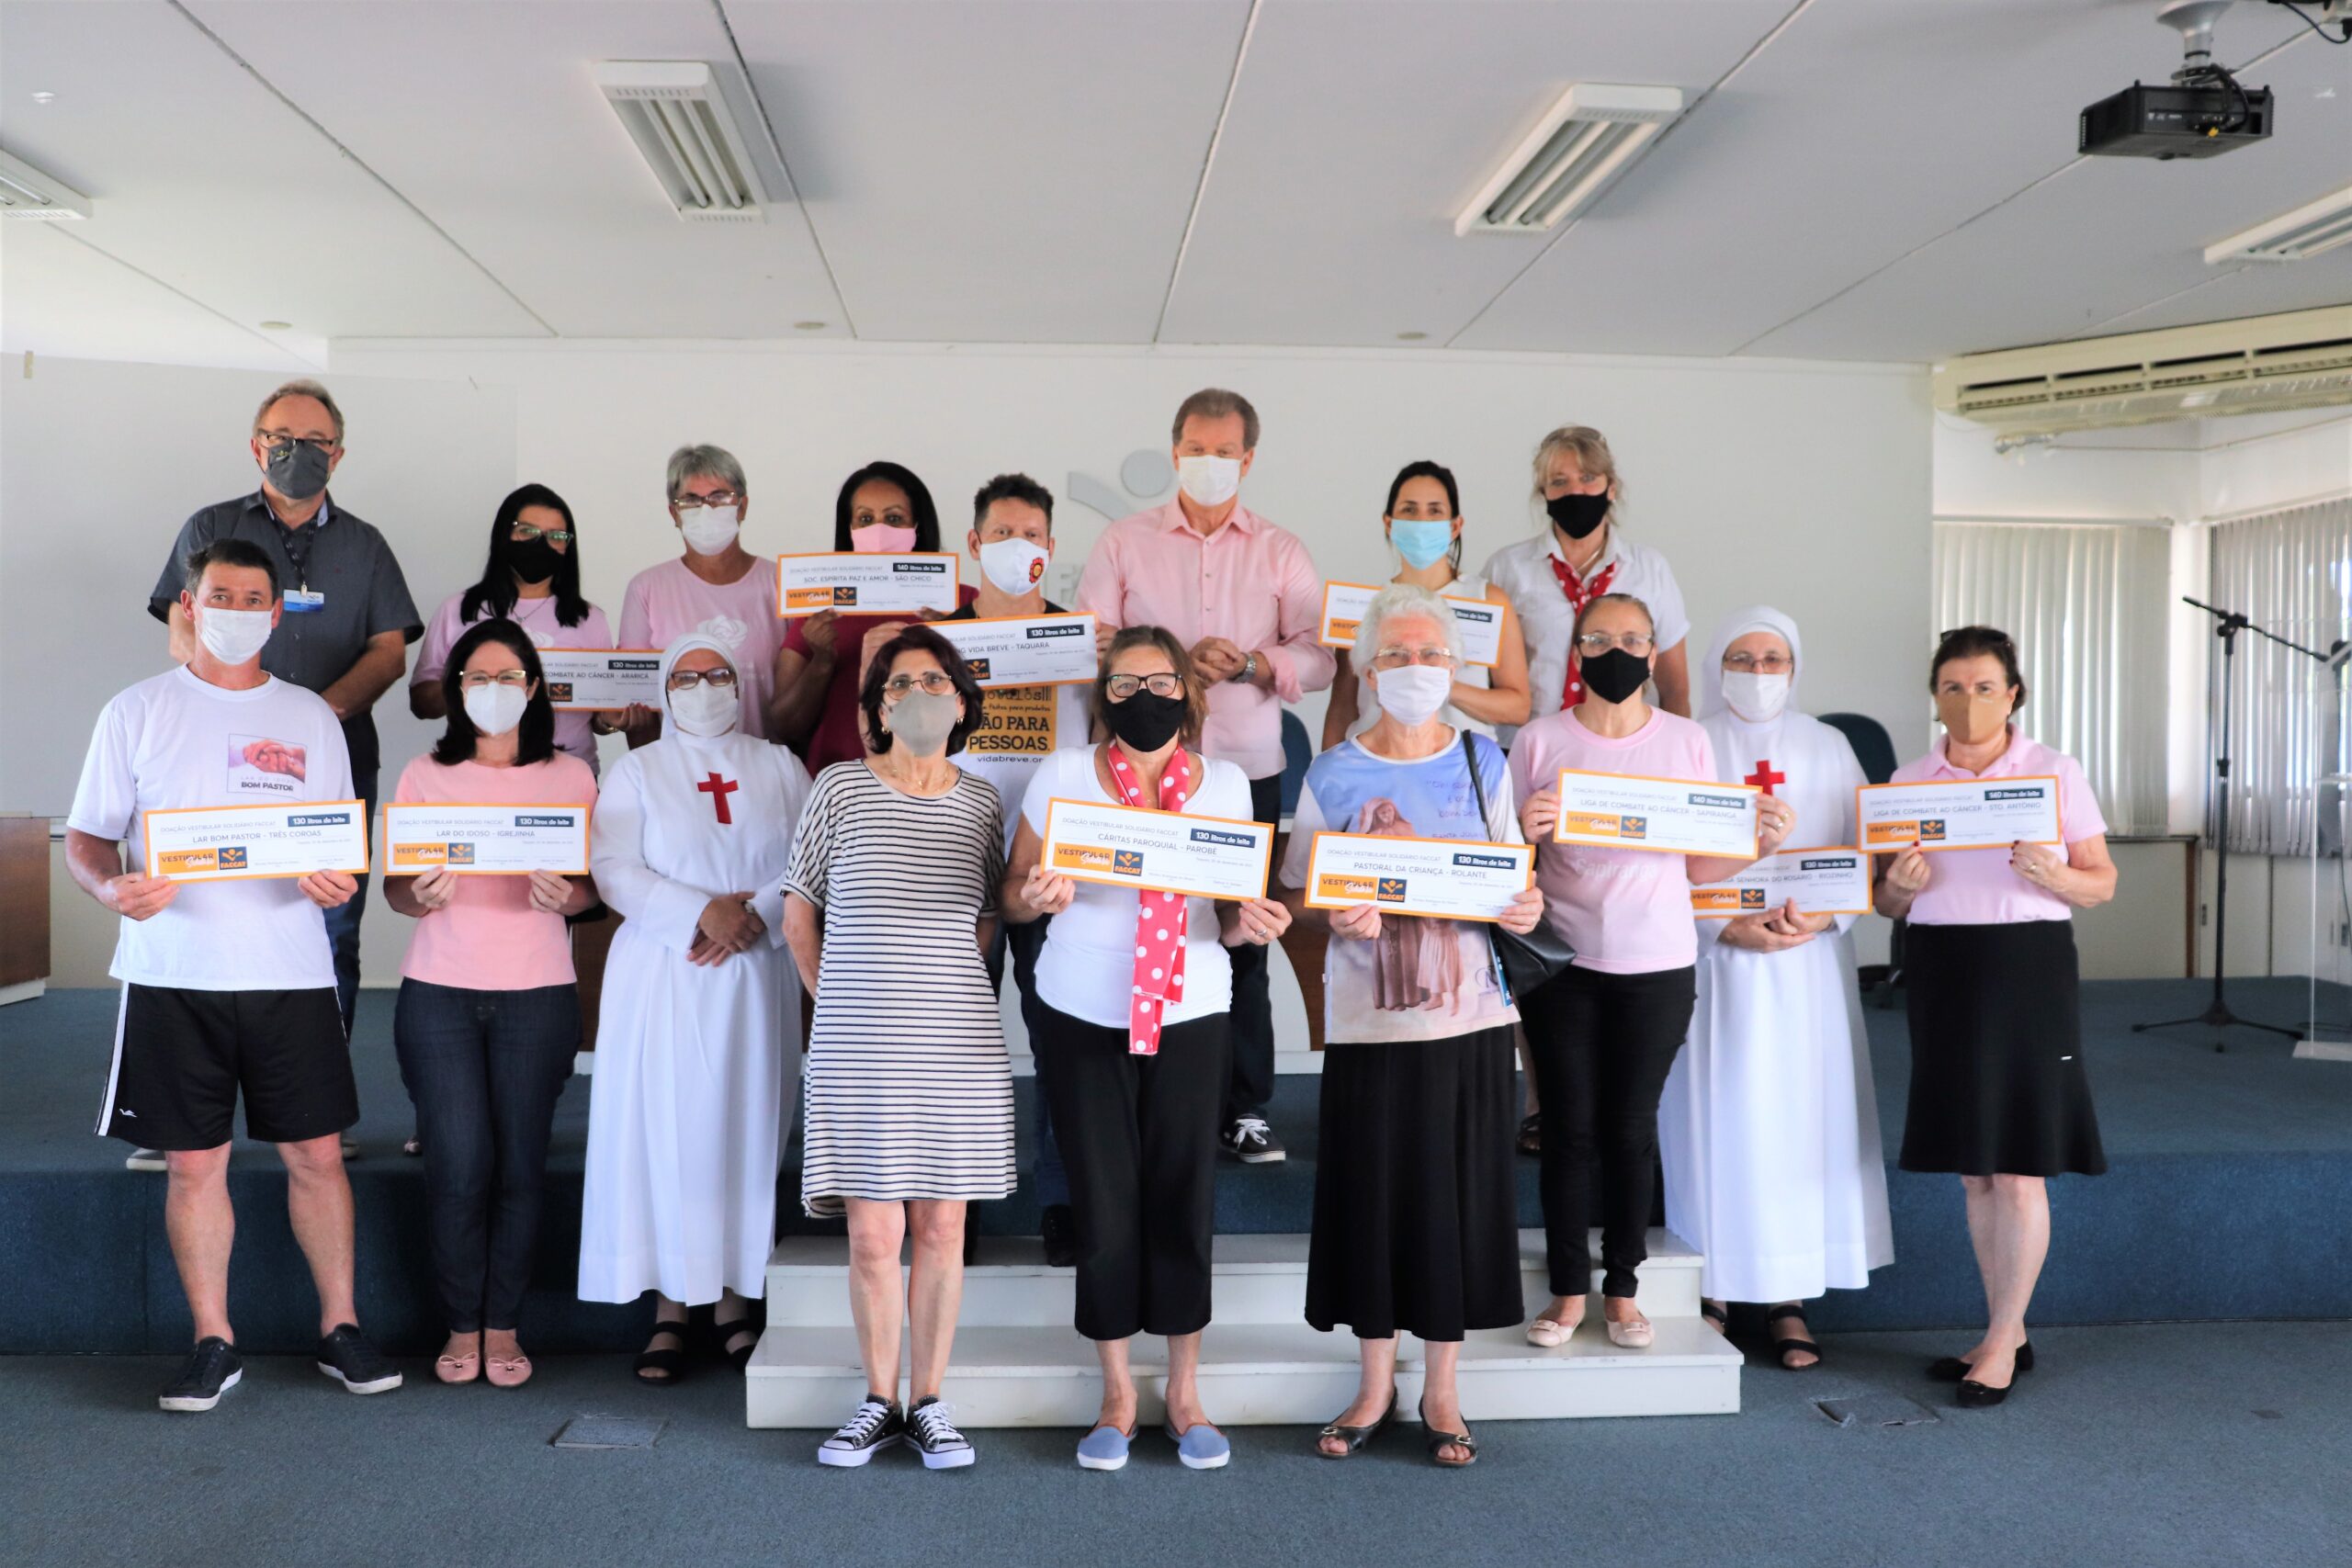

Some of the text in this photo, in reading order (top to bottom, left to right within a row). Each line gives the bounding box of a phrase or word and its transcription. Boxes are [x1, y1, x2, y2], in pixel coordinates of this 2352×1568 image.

[1016, 642, 1049, 650] TAQUARA
[978, 713, 1050, 731] ÃO PARA
[969, 736, 1050, 751] PESSOAS.
[263, 783, 293, 791] PASTOR
[1580, 799, 1596, 807] LIGA
[1611, 802, 1645, 811] COMBATE
[1660, 805, 1690, 815] CÂNCER
[1697, 808, 1736, 818] SAPIRANGA
[1952, 804, 1982, 813] CÂNCER
[2007, 801, 2041, 810] ANTÔNIO
[307, 817, 322, 825] litros
[1062, 818, 1088, 827] DOAÇÃO
[1089, 820, 1124, 830] VESTIBULAR
[1125, 825, 1155, 833] SOLIDÁRIO
[231, 833, 260, 841] PASTOR
[269, 831, 287, 840] TRÊS
[288, 830, 321, 839] COROAS
[1196, 831, 1250, 845] 130 litros de leite
[1098, 833, 1131, 844] CÁRITAS
[1134, 838, 1178, 850] PAROQUIAL
[1186, 843, 1217, 854] PAROBÉ
[1057, 848, 1110, 860] VESTIBULAR
[1458, 856, 1510, 867] 130 litros de leite
[1114, 865, 1141, 874] FACCAT
[1353, 863, 1393, 872] PASTORAL
[1396, 865, 1407, 874] DA
[1408, 866, 1443, 876] CRIANÇA
[1451, 869, 1487, 879] ROLANTE
[1322, 878, 1374, 887] VESTIBULAR
